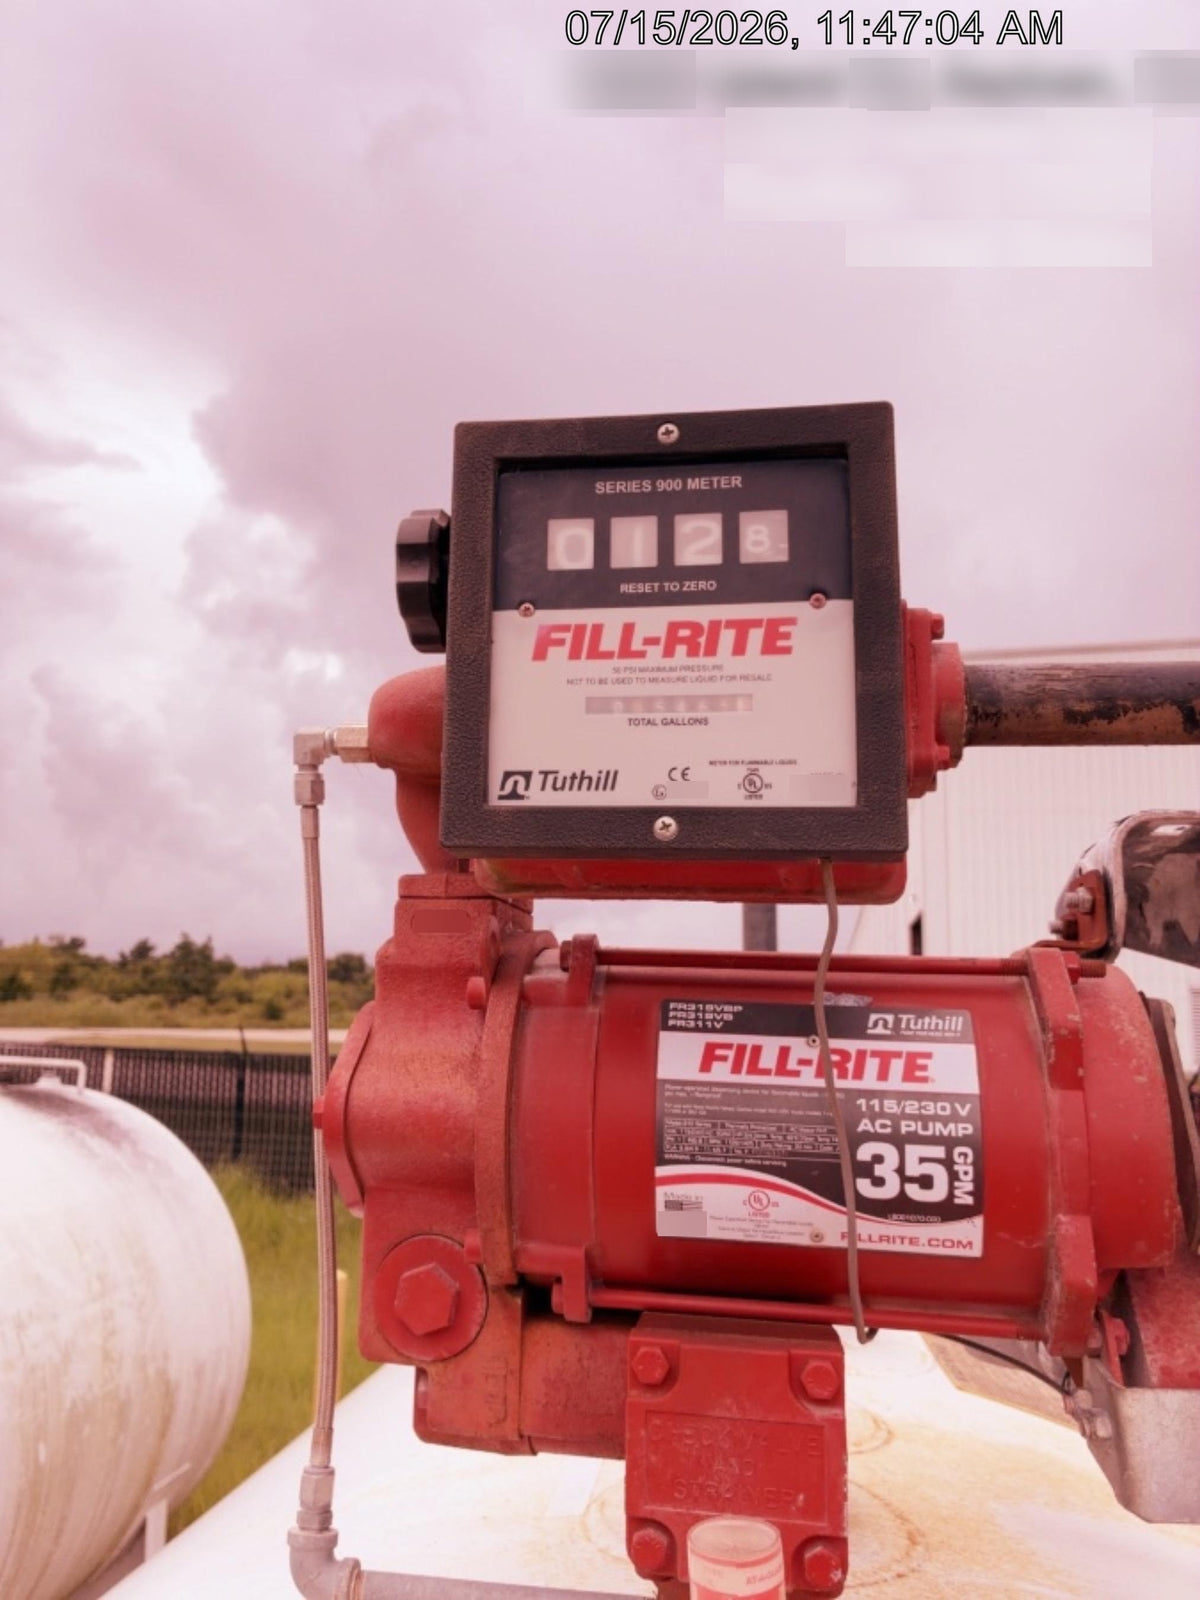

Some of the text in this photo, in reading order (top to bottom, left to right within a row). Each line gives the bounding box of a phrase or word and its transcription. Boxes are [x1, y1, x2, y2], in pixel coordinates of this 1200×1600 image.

[595, 475, 743, 494] SERIES 900 METER
[620, 580, 717, 594] RESET TO ZERO
[531, 616, 799, 662] FILL-RITE
[623, 665, 637, 674] PSI
[679, 663, 723, 673] PRESSURE
[566, 672, 773, 685] NOT TO BE USED TO MEASURE LIQUID FOR RESALE
[628, 716, 709, 727] TOTAL GALLONS
[538, 769, 619, 792] Tuthill
[898, 1014, 964, 1032] Tuthill
[698, 1041, 933, 1084] FILL-RITE
[856, 1098, 972, 1117] 115/230 V
[856, 1118, 974, 1137] AC PUMP
[855, 1140, 949, 1203] 35
[952, 1145, 975, 1206] GPM
[840, 1231, 974, 1250] FLLRITE.COM
